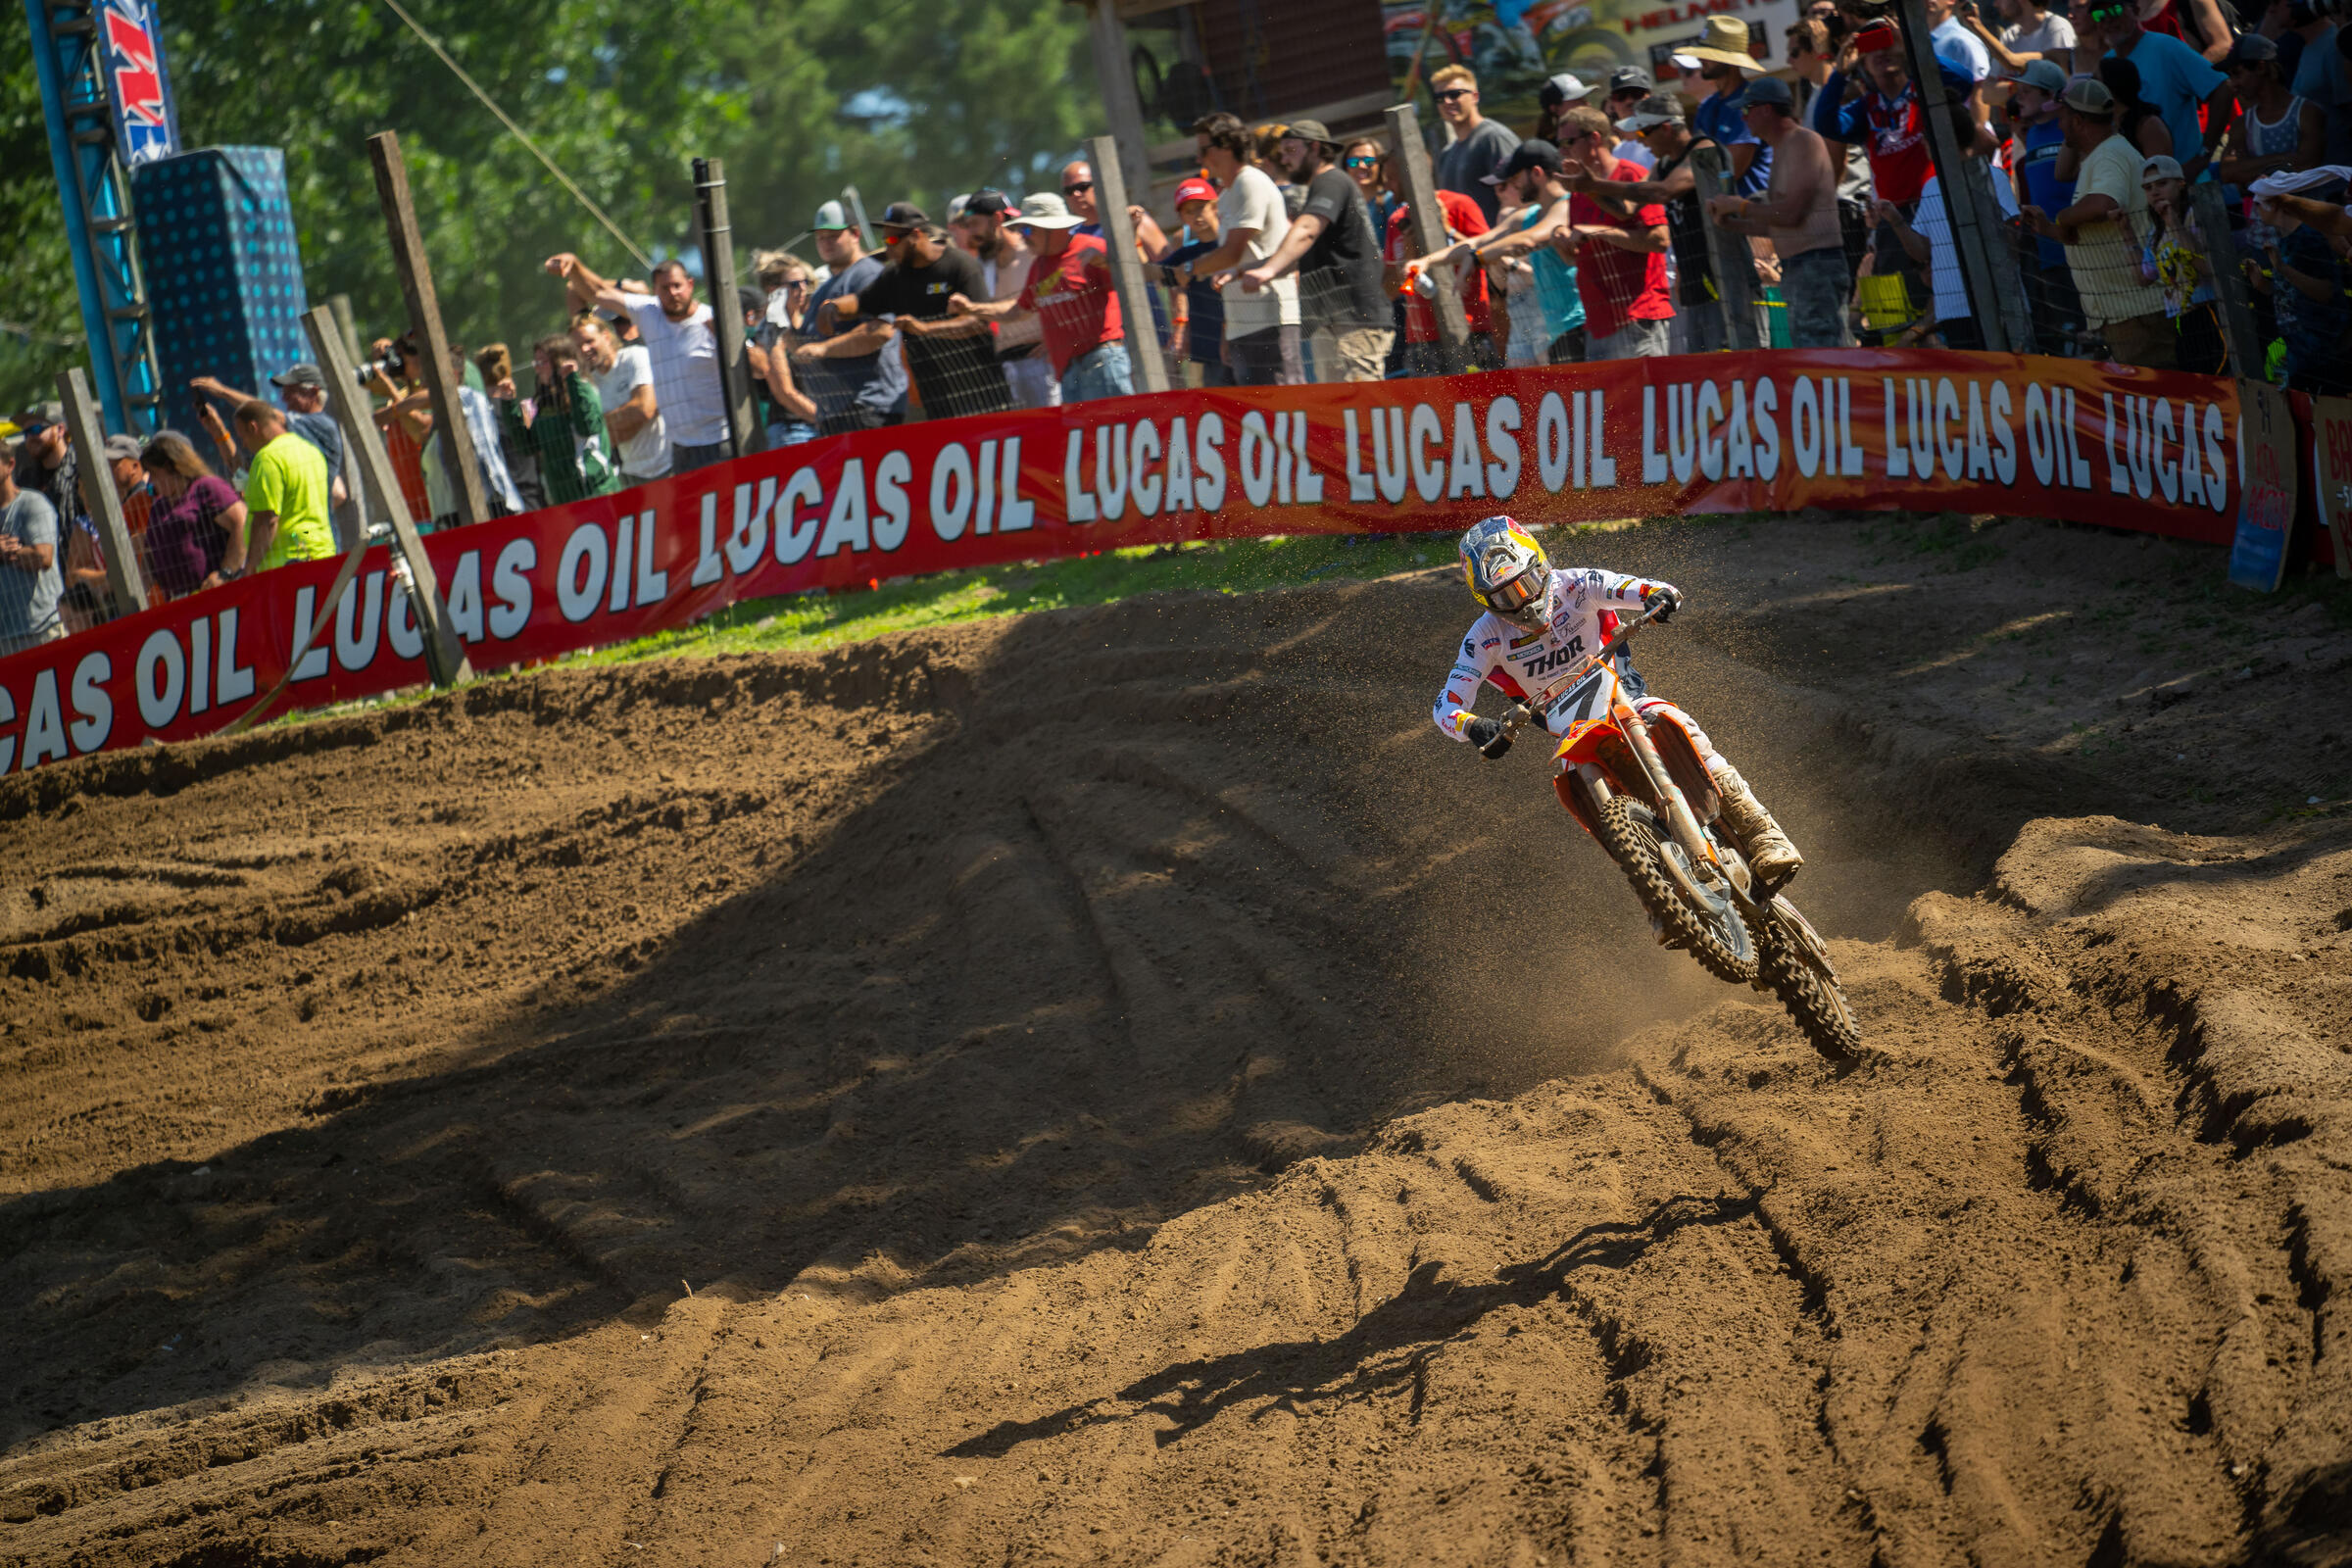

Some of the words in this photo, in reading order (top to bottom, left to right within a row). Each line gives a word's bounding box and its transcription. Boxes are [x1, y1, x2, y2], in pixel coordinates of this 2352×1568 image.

[135, 608, 255, 728] OIL
[556, 509, 668, 622] OIL
[691, 450, 913, 588] LUCAS
[929, 436, 1036, 542] OIL
[1064, 412, 1227, 523] LUCAS
[1240, 410, 1324, 508] OIL
[1344, 396, 1522, 504] LUCAS
[1536, 389, 1617, 493] OIL
[1642, 376, 1781, 485] LUCAS
[1791, 374, 1864, 479] OIL
[1883, 376, 2017, 486] LUCAS
[2025, 381, 2092, 489] OIL
[2103, 392, 2227, 513] LUCAS
[1523, 635, 1586, 677] THOR
[1557, 682, 1576, 702] LUCAS
[1576, 674, 1587, 686] OIL
[1558, 670, 1602, 723] 7
